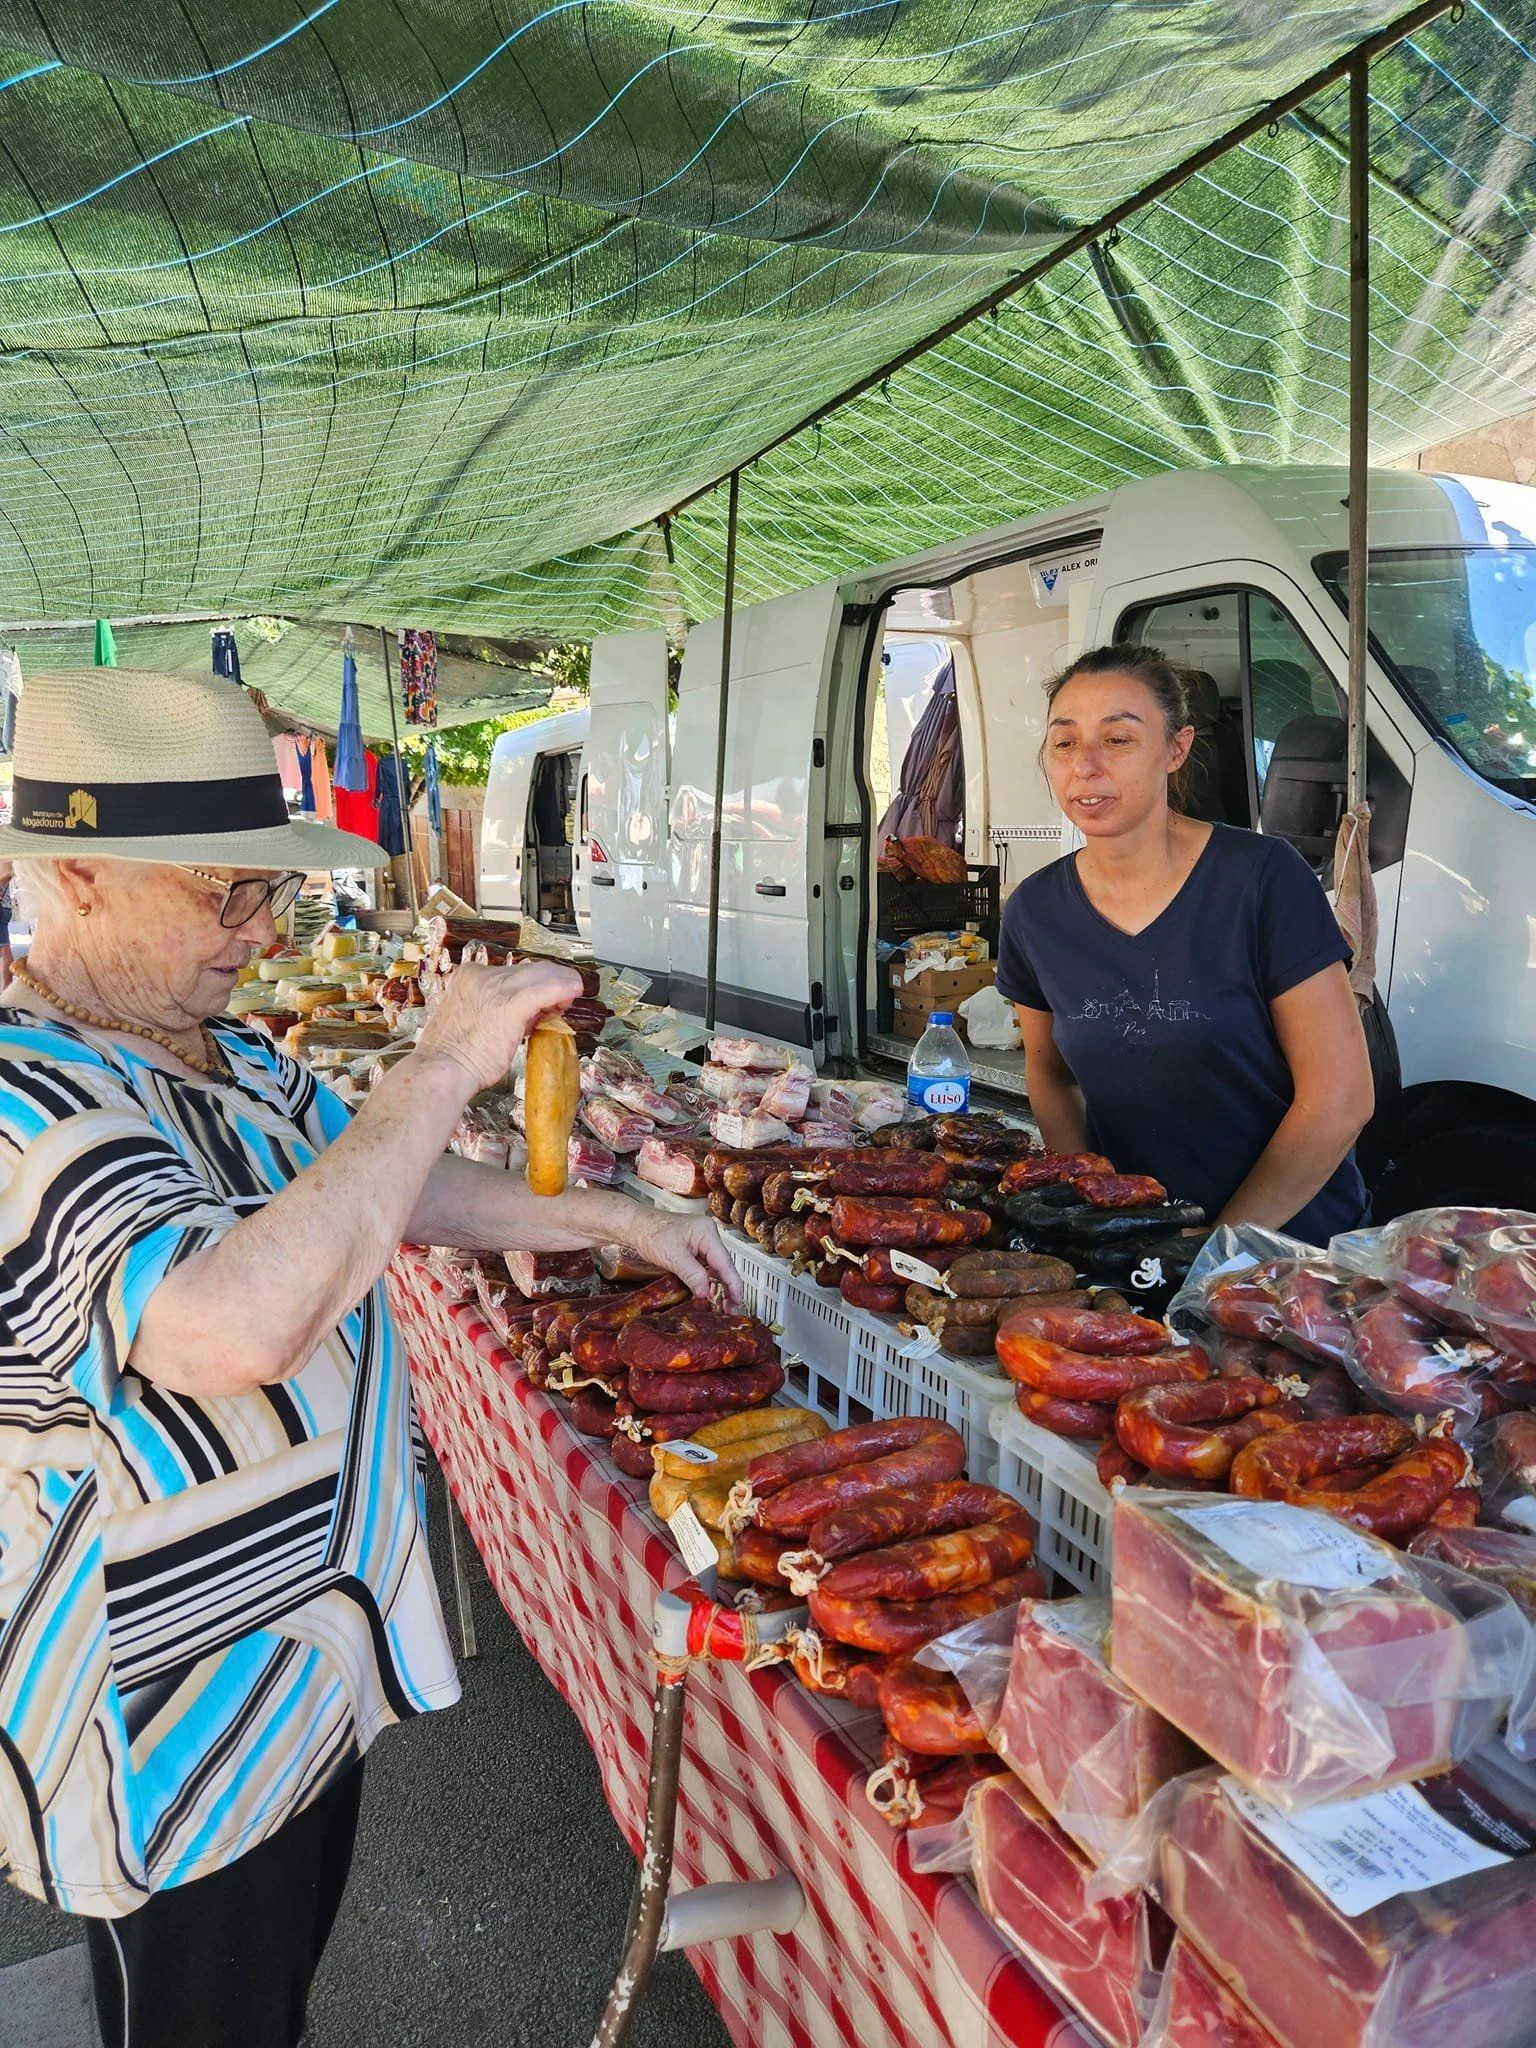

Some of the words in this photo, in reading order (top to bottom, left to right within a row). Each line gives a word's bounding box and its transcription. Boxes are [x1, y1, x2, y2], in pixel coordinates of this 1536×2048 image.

[1061, 562, 1081, 573] ALEX
[22, 816, 64, 828] Mogadouro
[930, 1093, 961, 1104] LUSO
